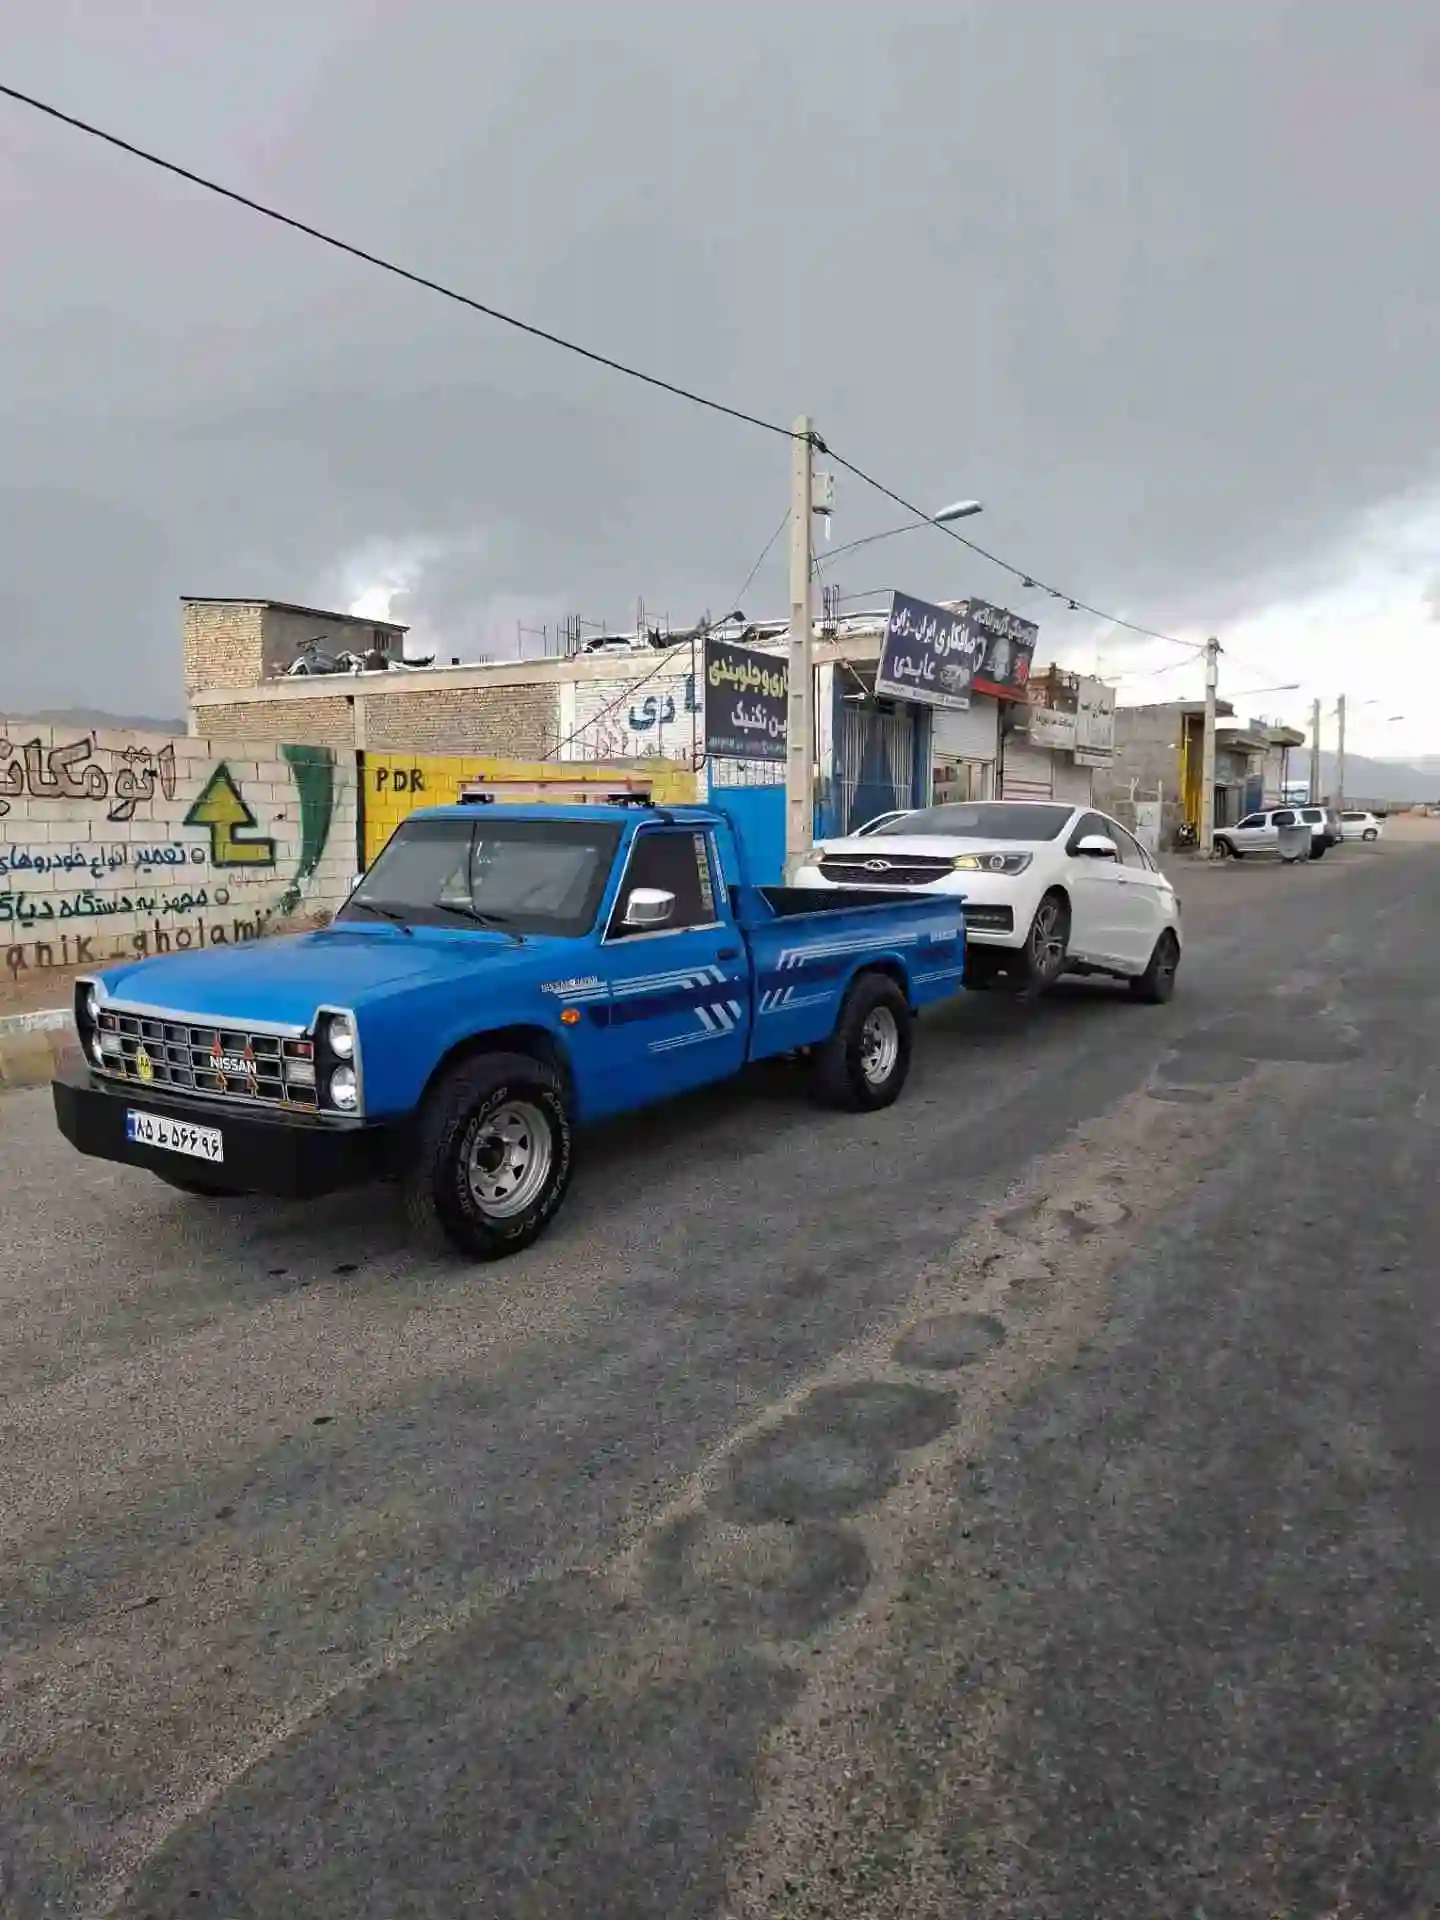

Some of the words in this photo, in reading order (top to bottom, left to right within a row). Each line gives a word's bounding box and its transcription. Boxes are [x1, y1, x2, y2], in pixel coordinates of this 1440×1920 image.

[375, 767, 425, 793] PDR
[90, 843, 128, 878] انواع
[134, 841, 186, 873] تعمیر
[59, 887, 136, 918] دستگاه
[161, 887, 208, 915] مجهز
[209, 1055, 257, 1074] NISSAN
